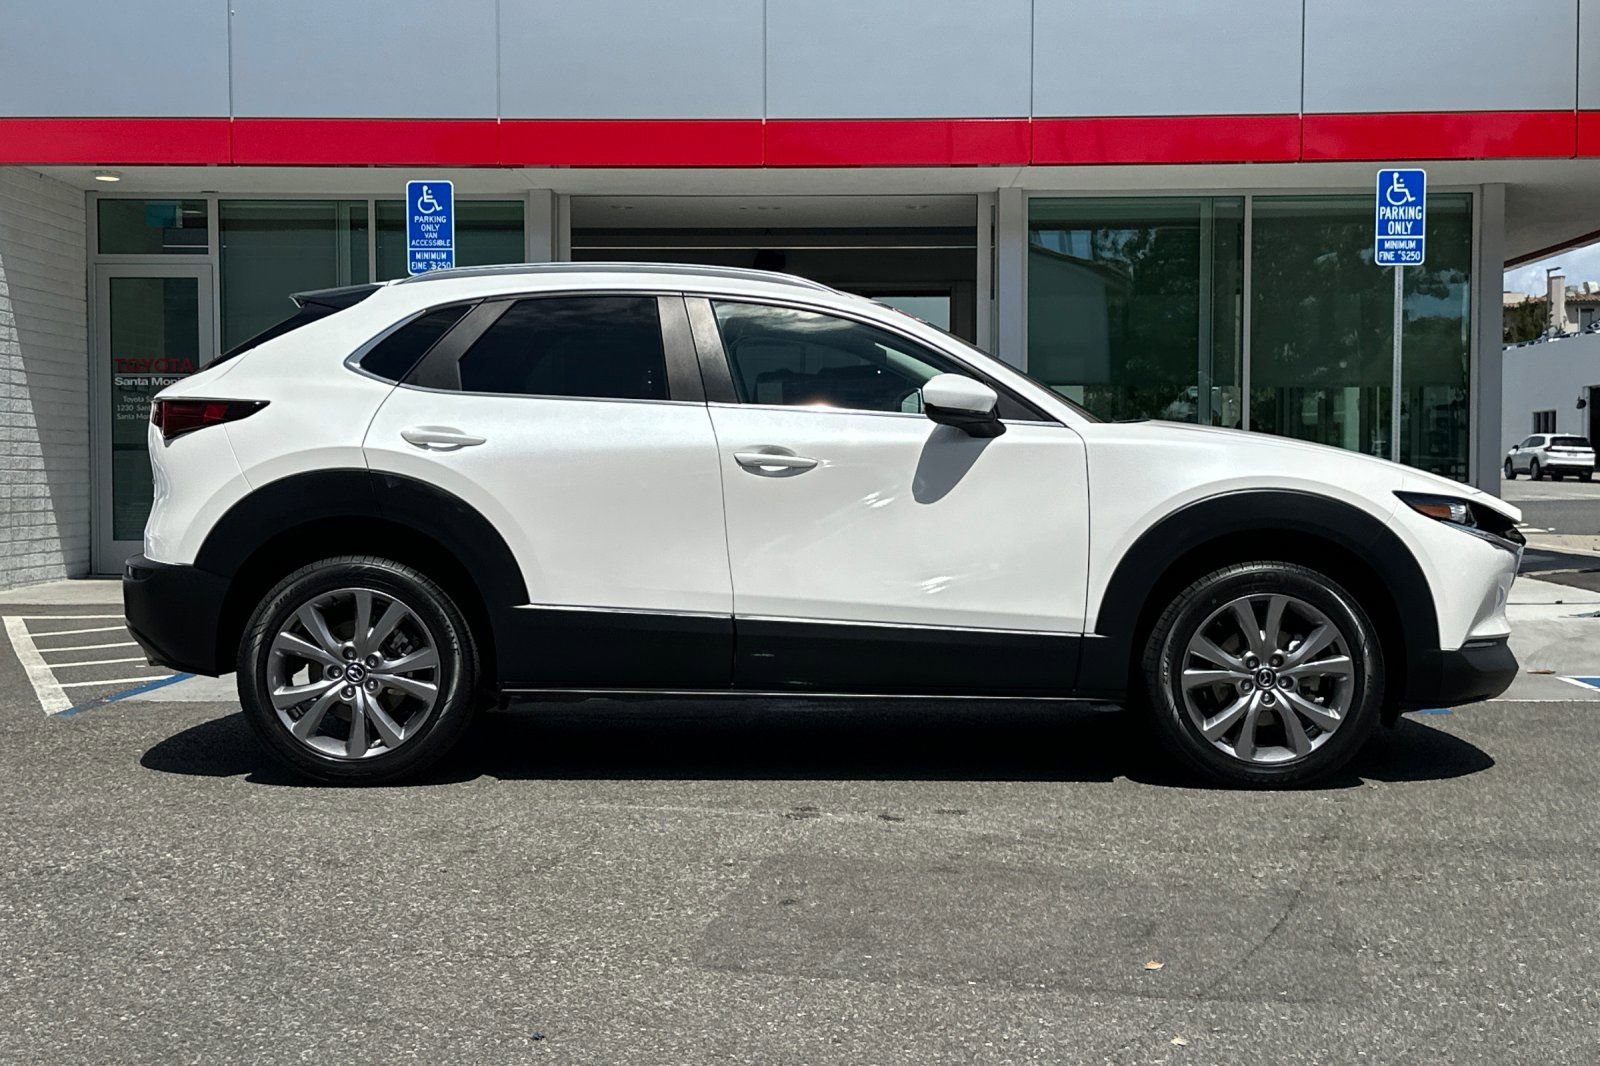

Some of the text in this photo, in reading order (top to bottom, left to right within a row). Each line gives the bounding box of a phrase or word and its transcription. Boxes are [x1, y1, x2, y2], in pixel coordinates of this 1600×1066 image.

[1380, 206, 1422, 220] PARKING
[1388, 221, 1413, 235] ONLY
[1384, 240, 1416, 249] MINIMUM
[416, 251, 446, 259] MINIMUM
[1379, 251, 1421, 261] FINE $250
[411, 261, 427, 270] FINE
[114, 357, 193, 372] TOYOTA
[114, 377, 148, 386] Santa
